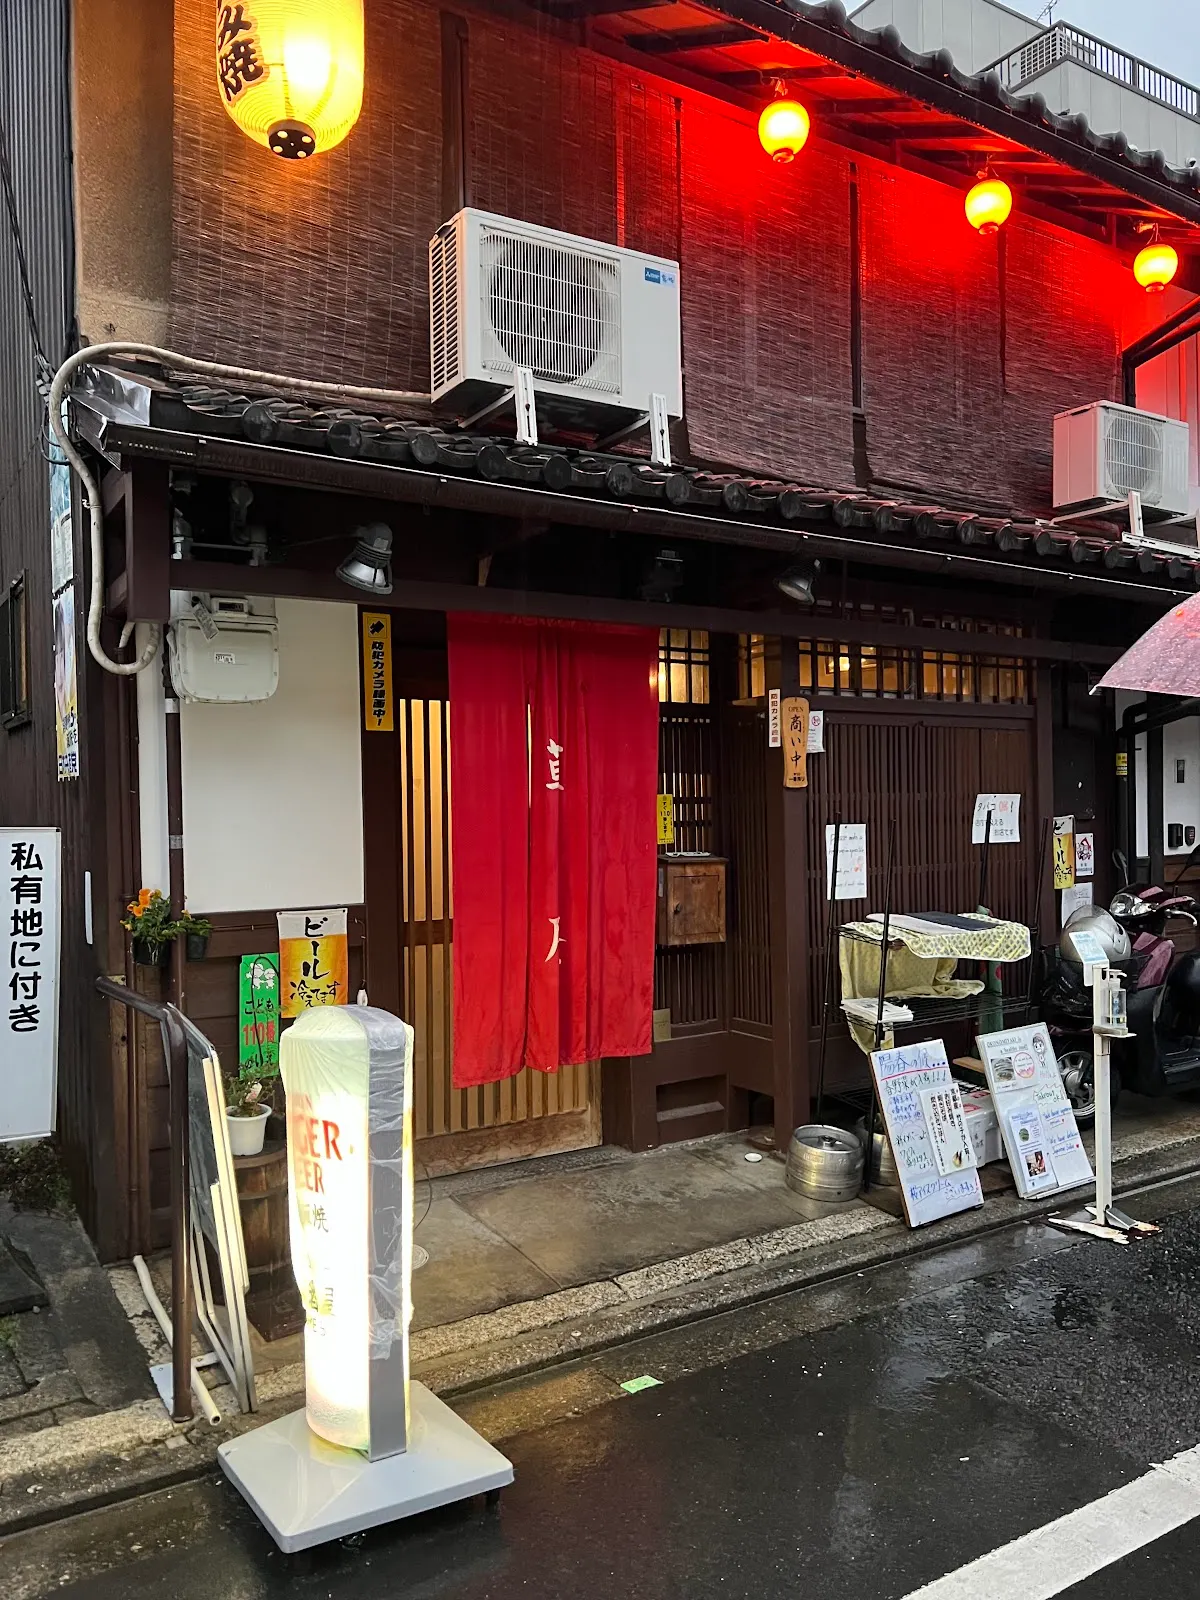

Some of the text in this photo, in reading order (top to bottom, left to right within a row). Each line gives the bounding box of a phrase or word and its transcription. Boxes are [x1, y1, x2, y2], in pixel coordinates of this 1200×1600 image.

[790, 714, 802, 768] 商い中
[8, 842, 43, 1032] 私有地に付き
[302, 916, 330, 980] ビール
